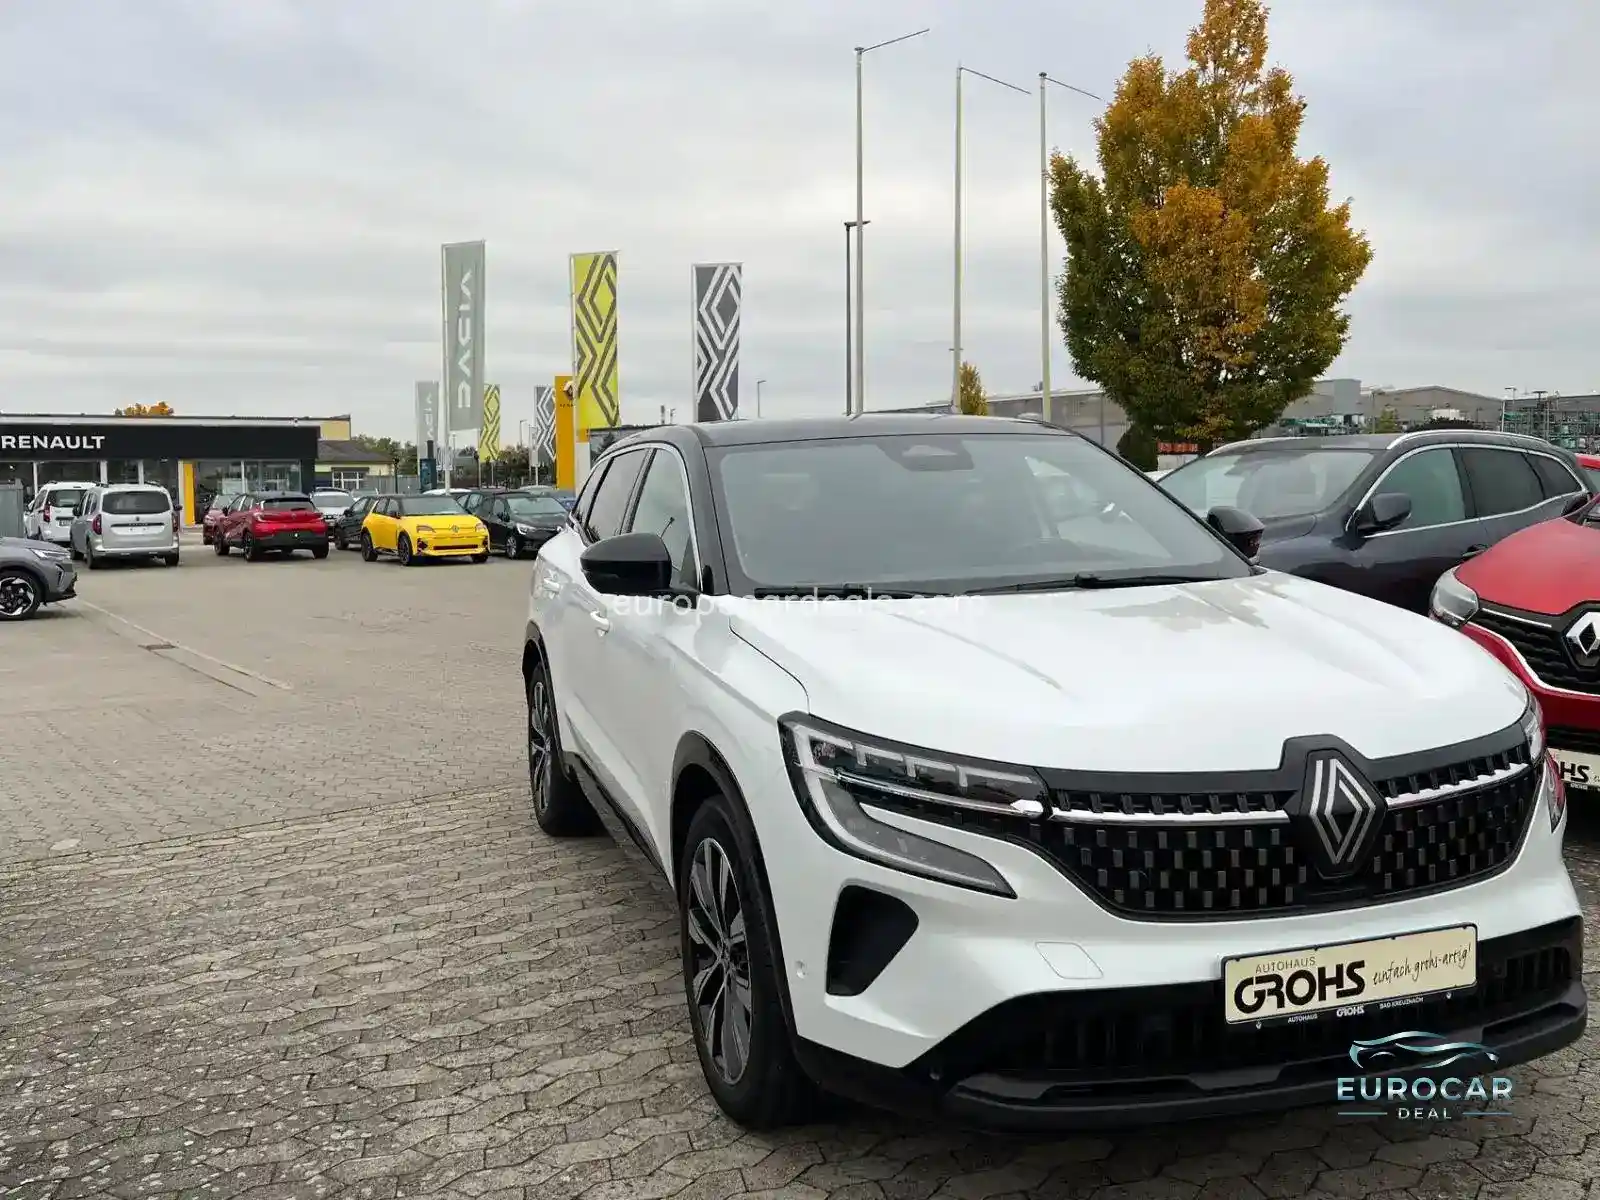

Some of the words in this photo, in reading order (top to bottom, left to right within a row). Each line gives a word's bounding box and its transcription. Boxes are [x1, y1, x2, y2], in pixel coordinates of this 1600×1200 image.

[1, 435, 106, 449] RENAULT
[1255, 956, 1316, 974] AUTOHAUS
[1373, 957, 1411, 985] einfach
[1234, 960, 1366, 1014] GROHS
[1287, 1013, 1318, 1023] AUTOHAUS
[1336, 1005, 1365, 1018] GROHS
[1380, 1001, 1391, 1010] BAD
[1391, 996, 1424, 1007] KREUZNACH
